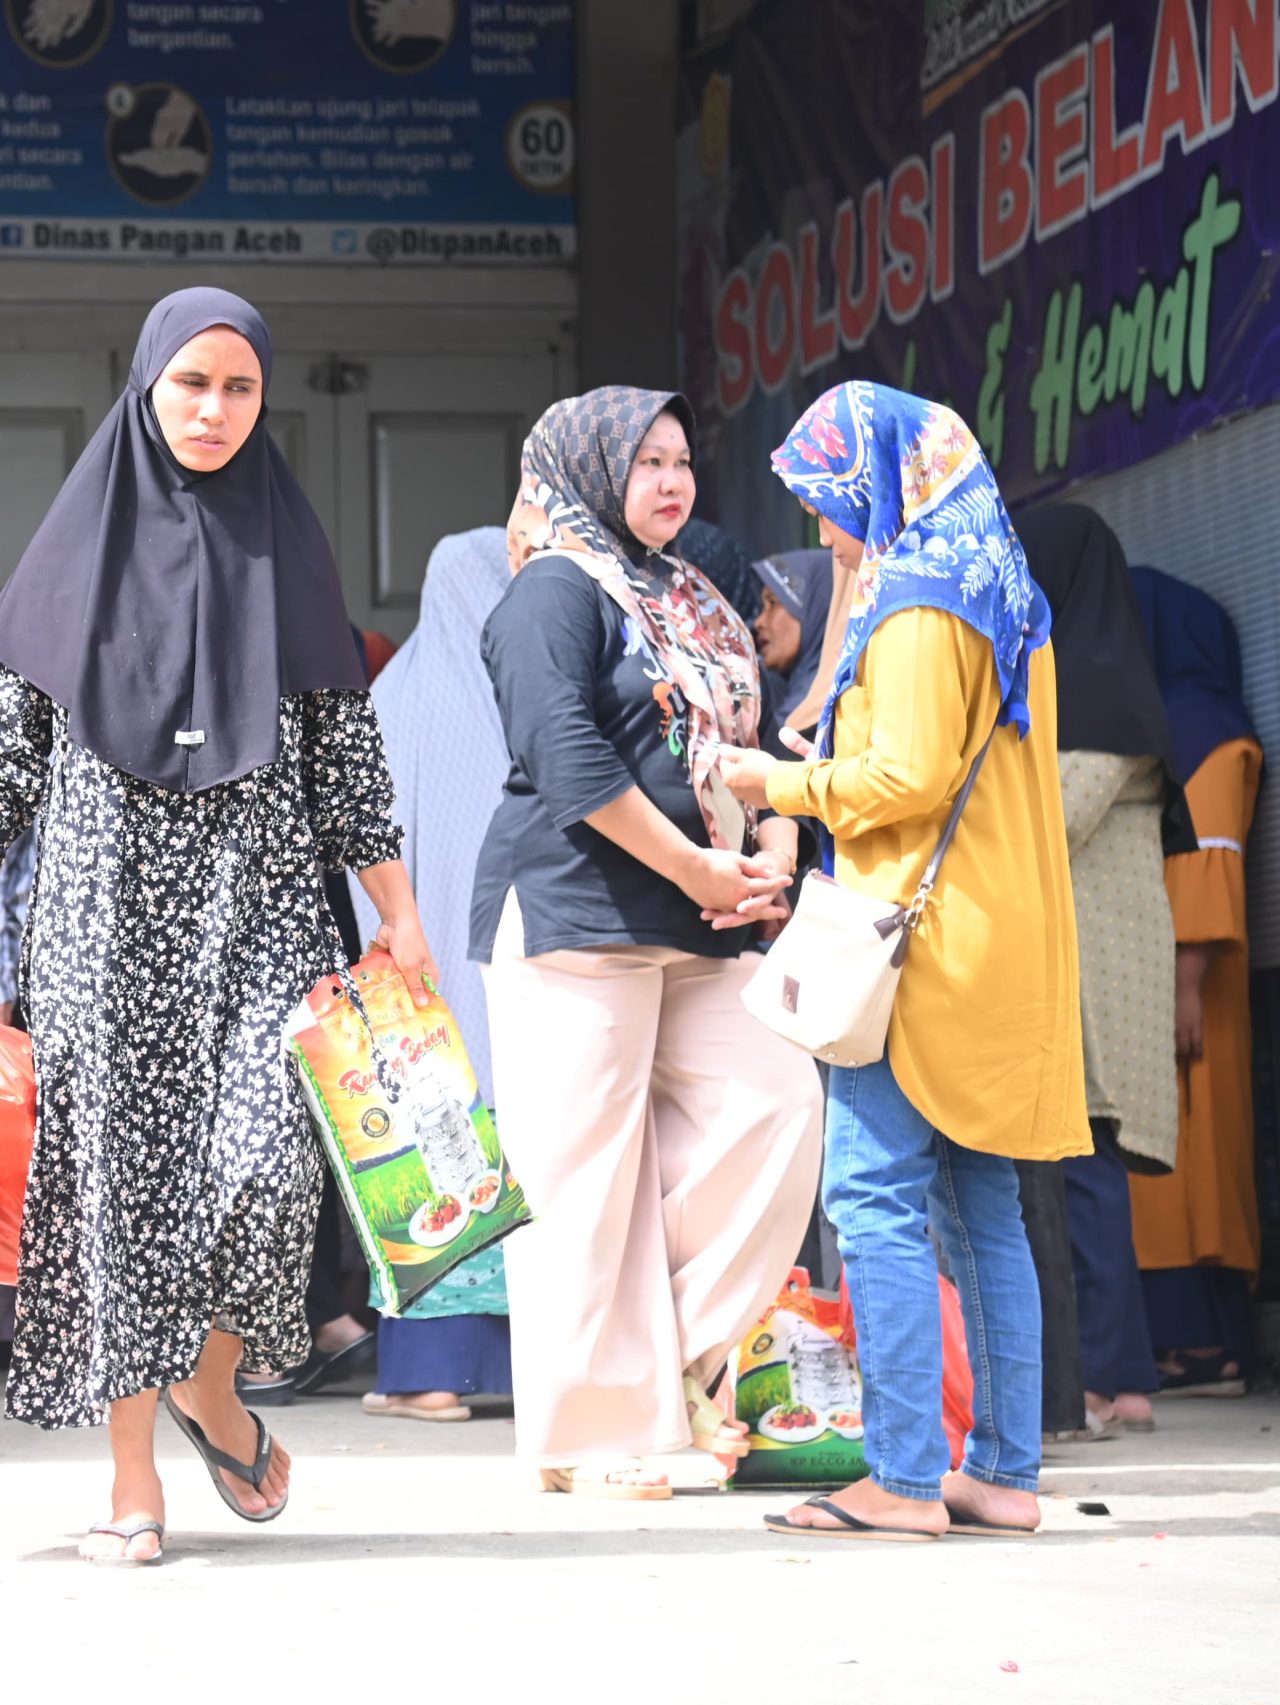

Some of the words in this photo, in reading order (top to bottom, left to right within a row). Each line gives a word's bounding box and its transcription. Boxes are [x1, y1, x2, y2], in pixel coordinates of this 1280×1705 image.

[522, 117, 565, 156] 60
[718, 132, 956, 416] SOLUSI
[977, 0, 1280, 276] BELAN
[32, 221, 111, 250] Dinas
[120, 225, 225, 256] Pangan
[233, 226, 302, 253] Aceh
[365, 227, 563, 261] @DispanAceh
